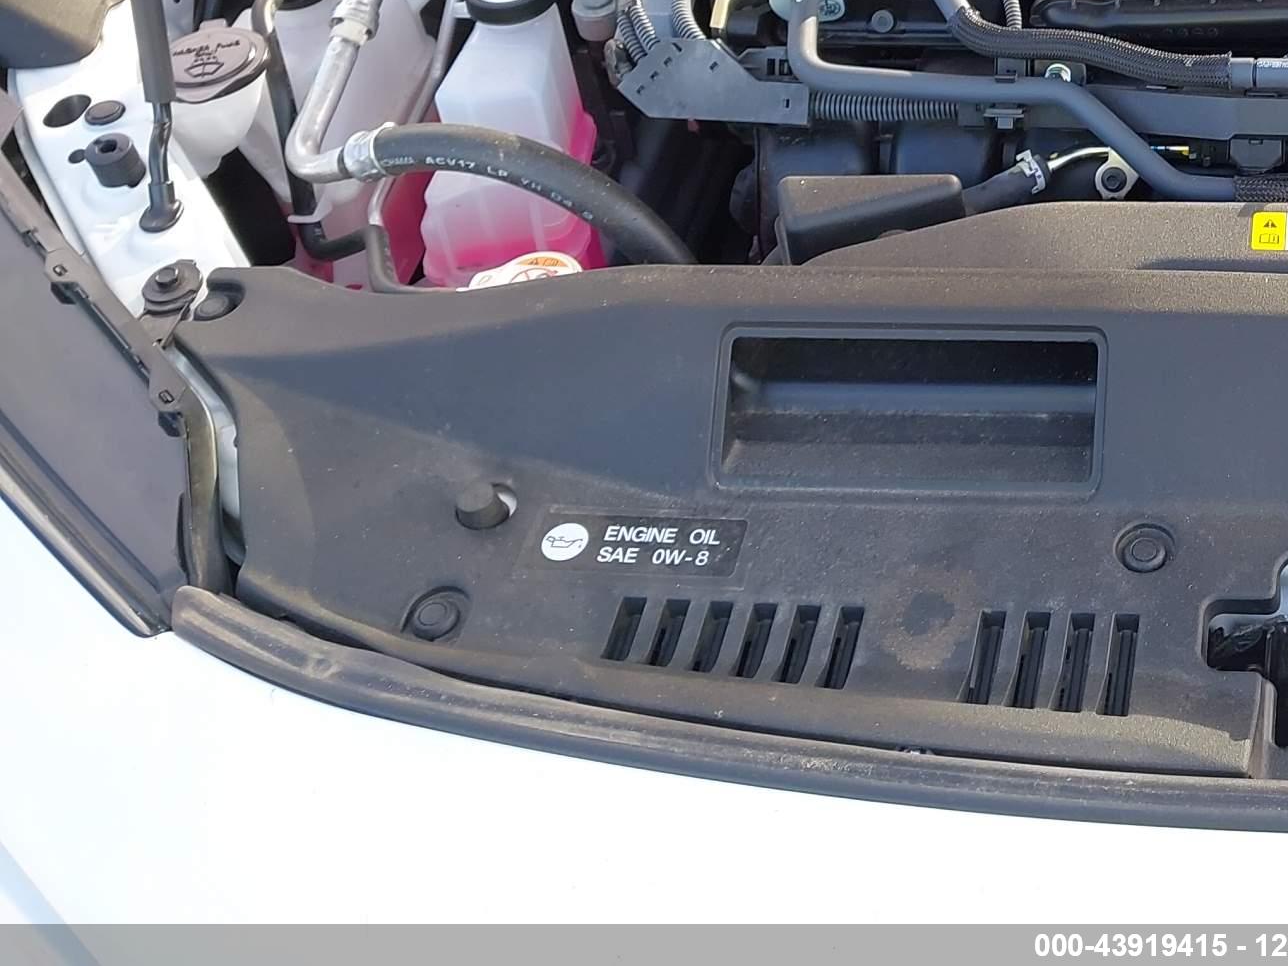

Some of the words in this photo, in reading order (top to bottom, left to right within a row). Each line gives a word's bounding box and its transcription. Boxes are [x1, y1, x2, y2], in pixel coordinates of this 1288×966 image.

[603, 525, 678, 544] ENGINE
[688, 528, 721, 546] OIL
[596, 547, 640, 564] SAE
[651, 548, 709, 566] 0W-8
